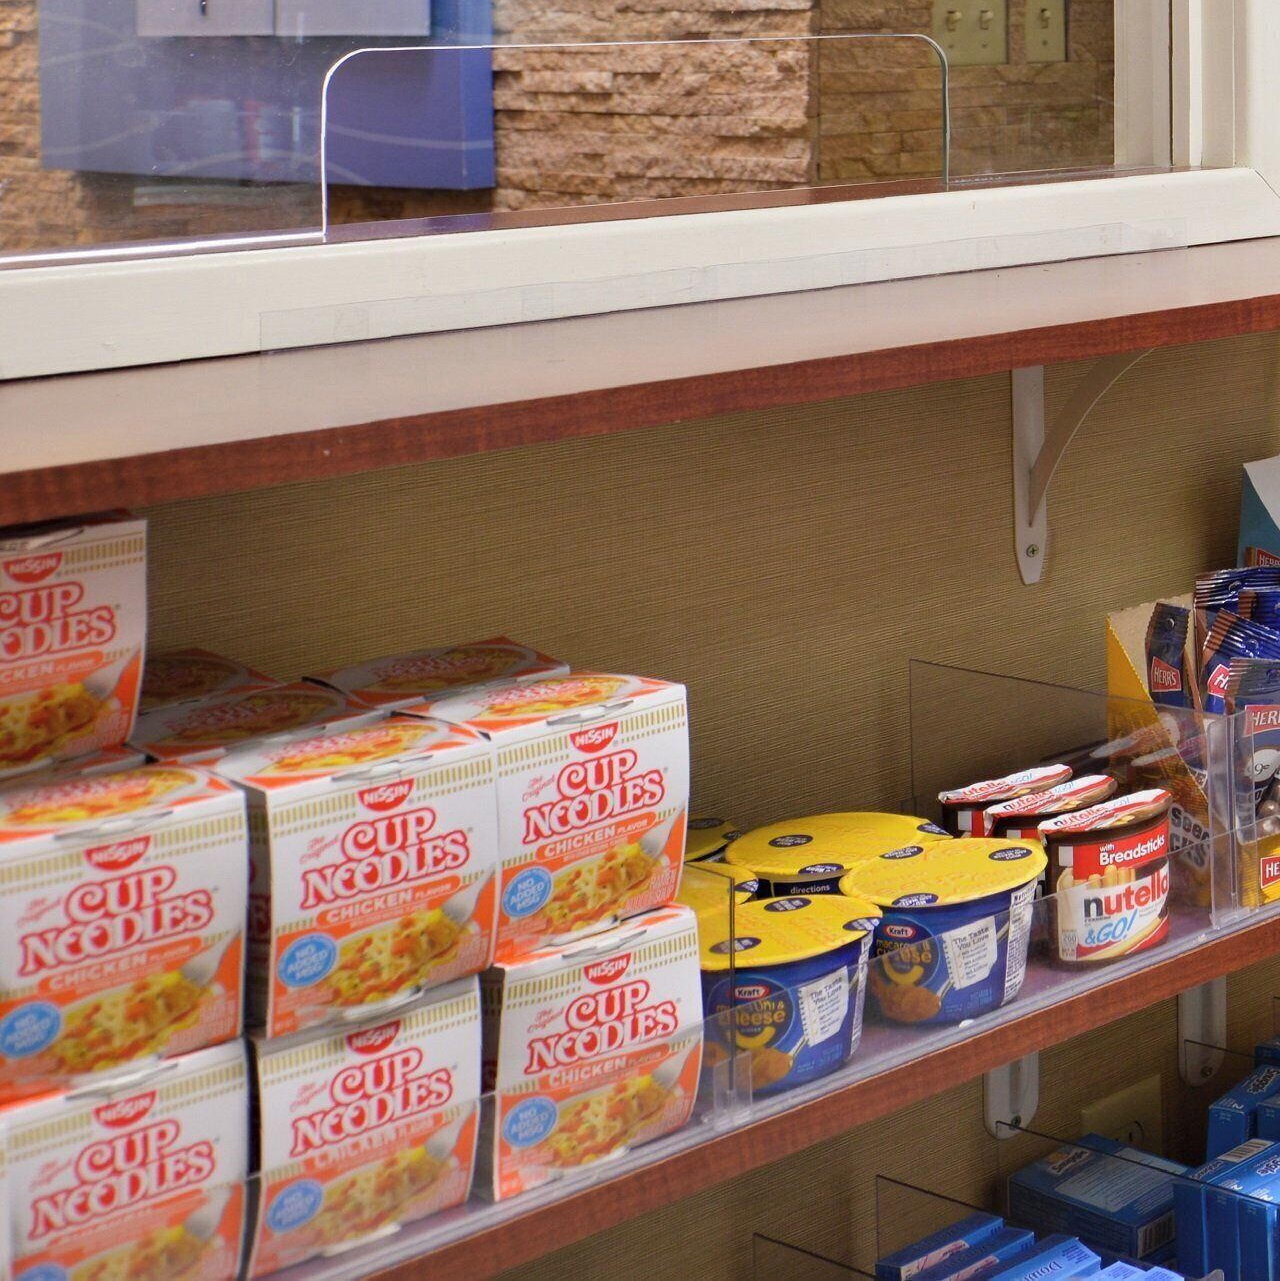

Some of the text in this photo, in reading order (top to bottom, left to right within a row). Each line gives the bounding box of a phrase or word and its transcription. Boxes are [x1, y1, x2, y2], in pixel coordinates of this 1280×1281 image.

[574, 727, 614, 746] NISSIN
[558, 749, 637, 797] CUP
[523, 769, 664, 844] NOODLES
[341, 807, 436, 861] CUP
[1099, 835, 1165, 866] Breadsticks
[64, 866, 176, 922] CUP
[300, 830, 470, 910] NOODLES
[1084, 873, 1170, 918] nutella
[18, 891, 214, 977] NOODLES
[563, 979, 651, 1029] CUP
[525, 1001, 679, 1076] NOODLES
